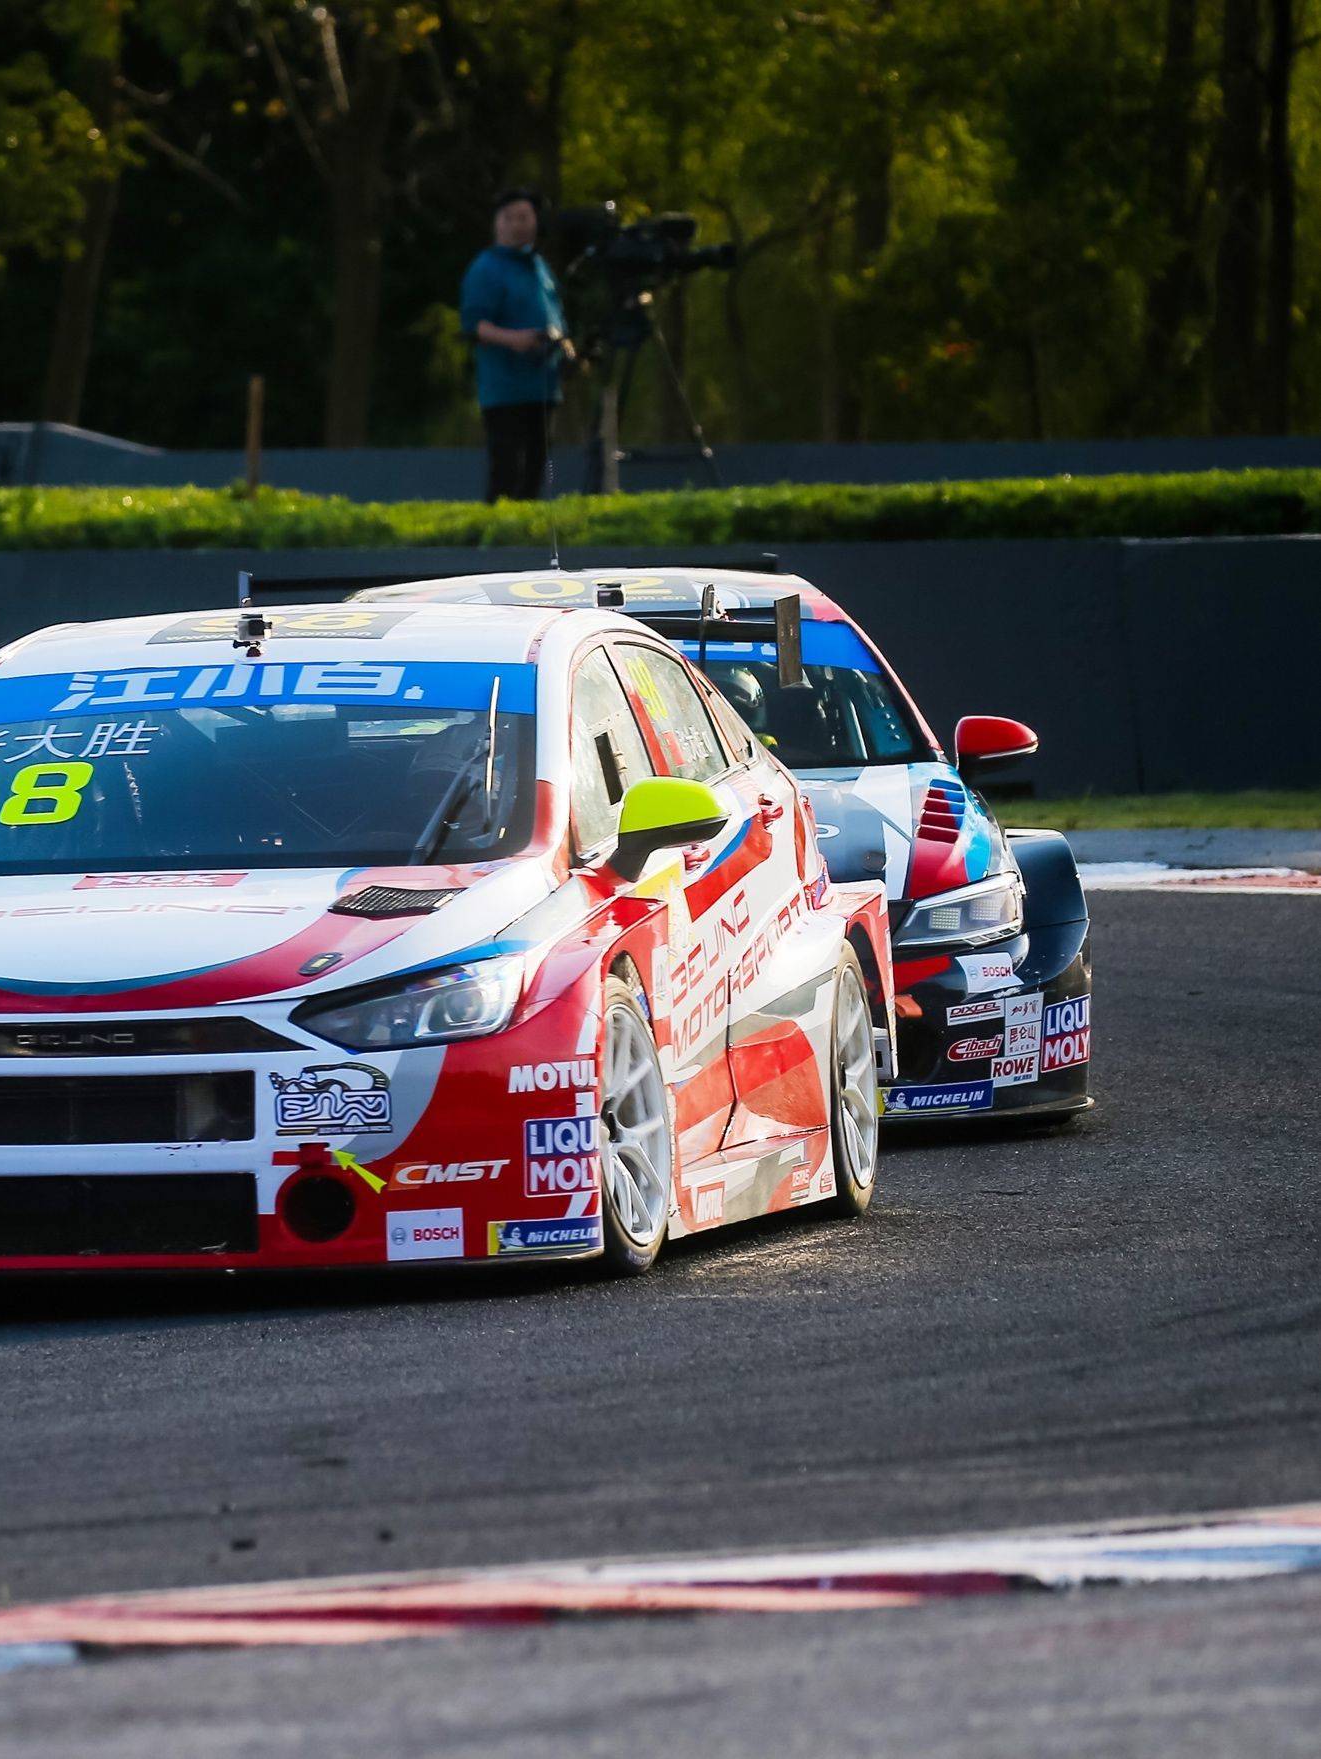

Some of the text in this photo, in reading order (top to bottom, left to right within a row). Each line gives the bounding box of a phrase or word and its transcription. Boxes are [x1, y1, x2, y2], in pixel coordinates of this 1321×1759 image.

[981, 965, 1012, 977] BOSCH
[1046, 1000, 1090, 1036] LIQUI
[1009, 1025, 1036, 1045] 昆仑山
[1044, 1030, 1091, 1068] MOLY
[508, 1060, 598, 1093] MOTUL
[993, 1056, 1035, 1078] ROWE
[911, 1090, 984, 1107] MICHELIN
[395, 1159, 511, 1185] CMST
[530, 1157, 601, 1192] MOLY
[413, 1226, 459, 1241] BOSCH
[526, 1226, 599, 1243] MICHELIN
